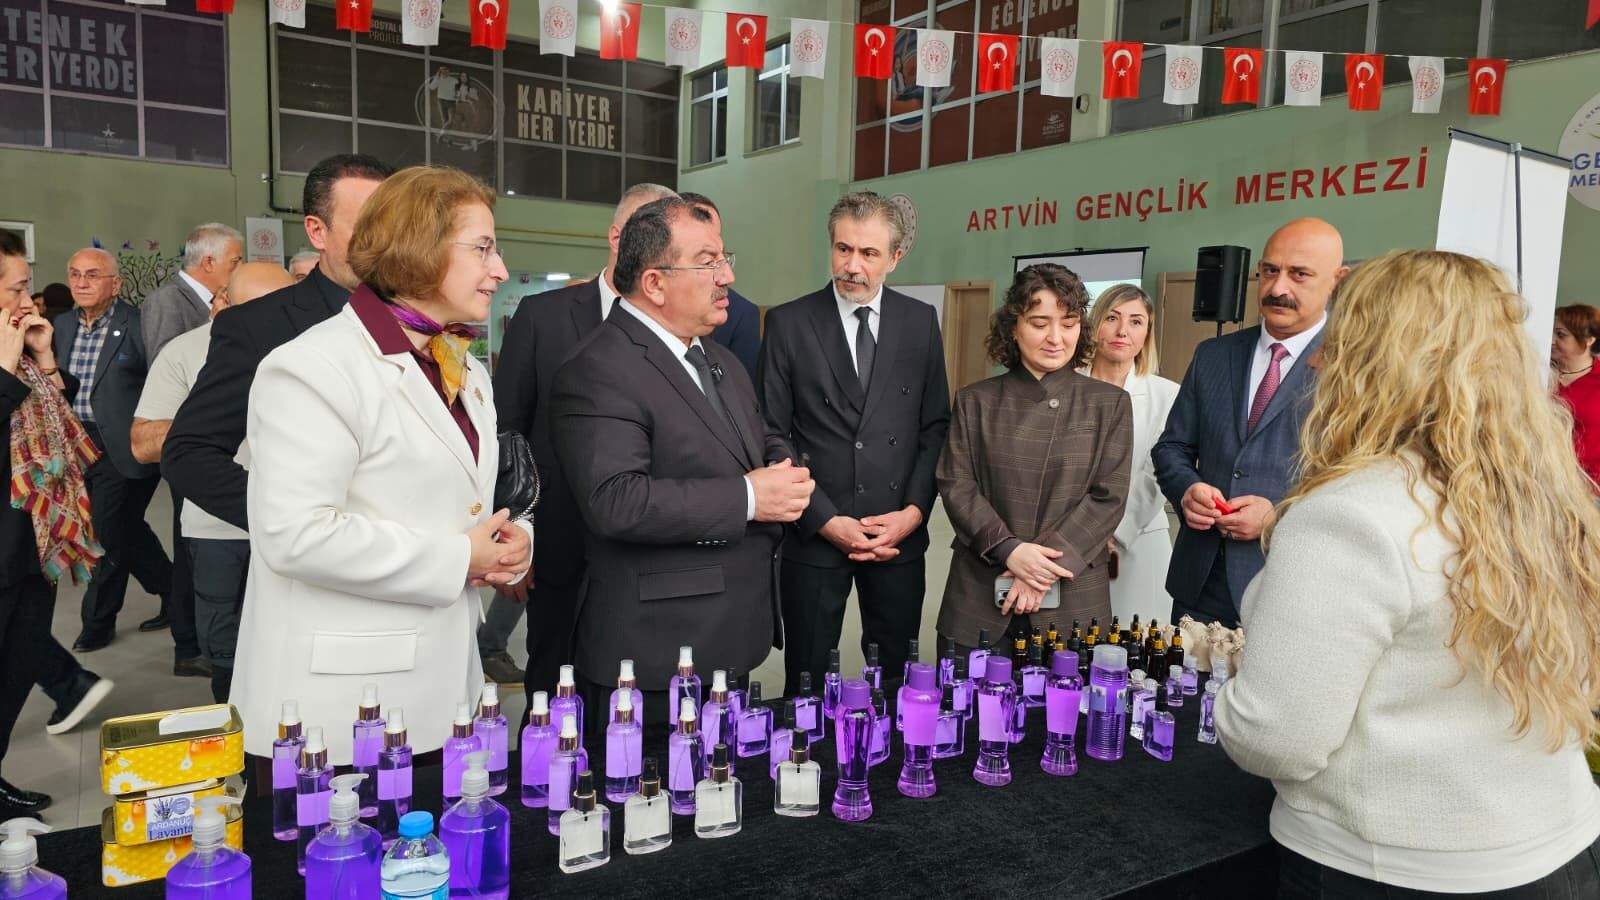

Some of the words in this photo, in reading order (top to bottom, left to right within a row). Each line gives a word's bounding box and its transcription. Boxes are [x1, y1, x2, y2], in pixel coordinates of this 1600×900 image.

[50, 50, 135, 93] YERDE
[517, 83, 611, 123] KARİYER
[517, 111, 554, 142] HER
[568, 119, 615, 150] YERDE
[966, 197, 1058, 232] ARTVİN
[1075, 178, 1208, 222] GENÇLİK
[1235, 146, 1428, 205] MERKEZİ
[1570, 173, 1600, 188] ME
